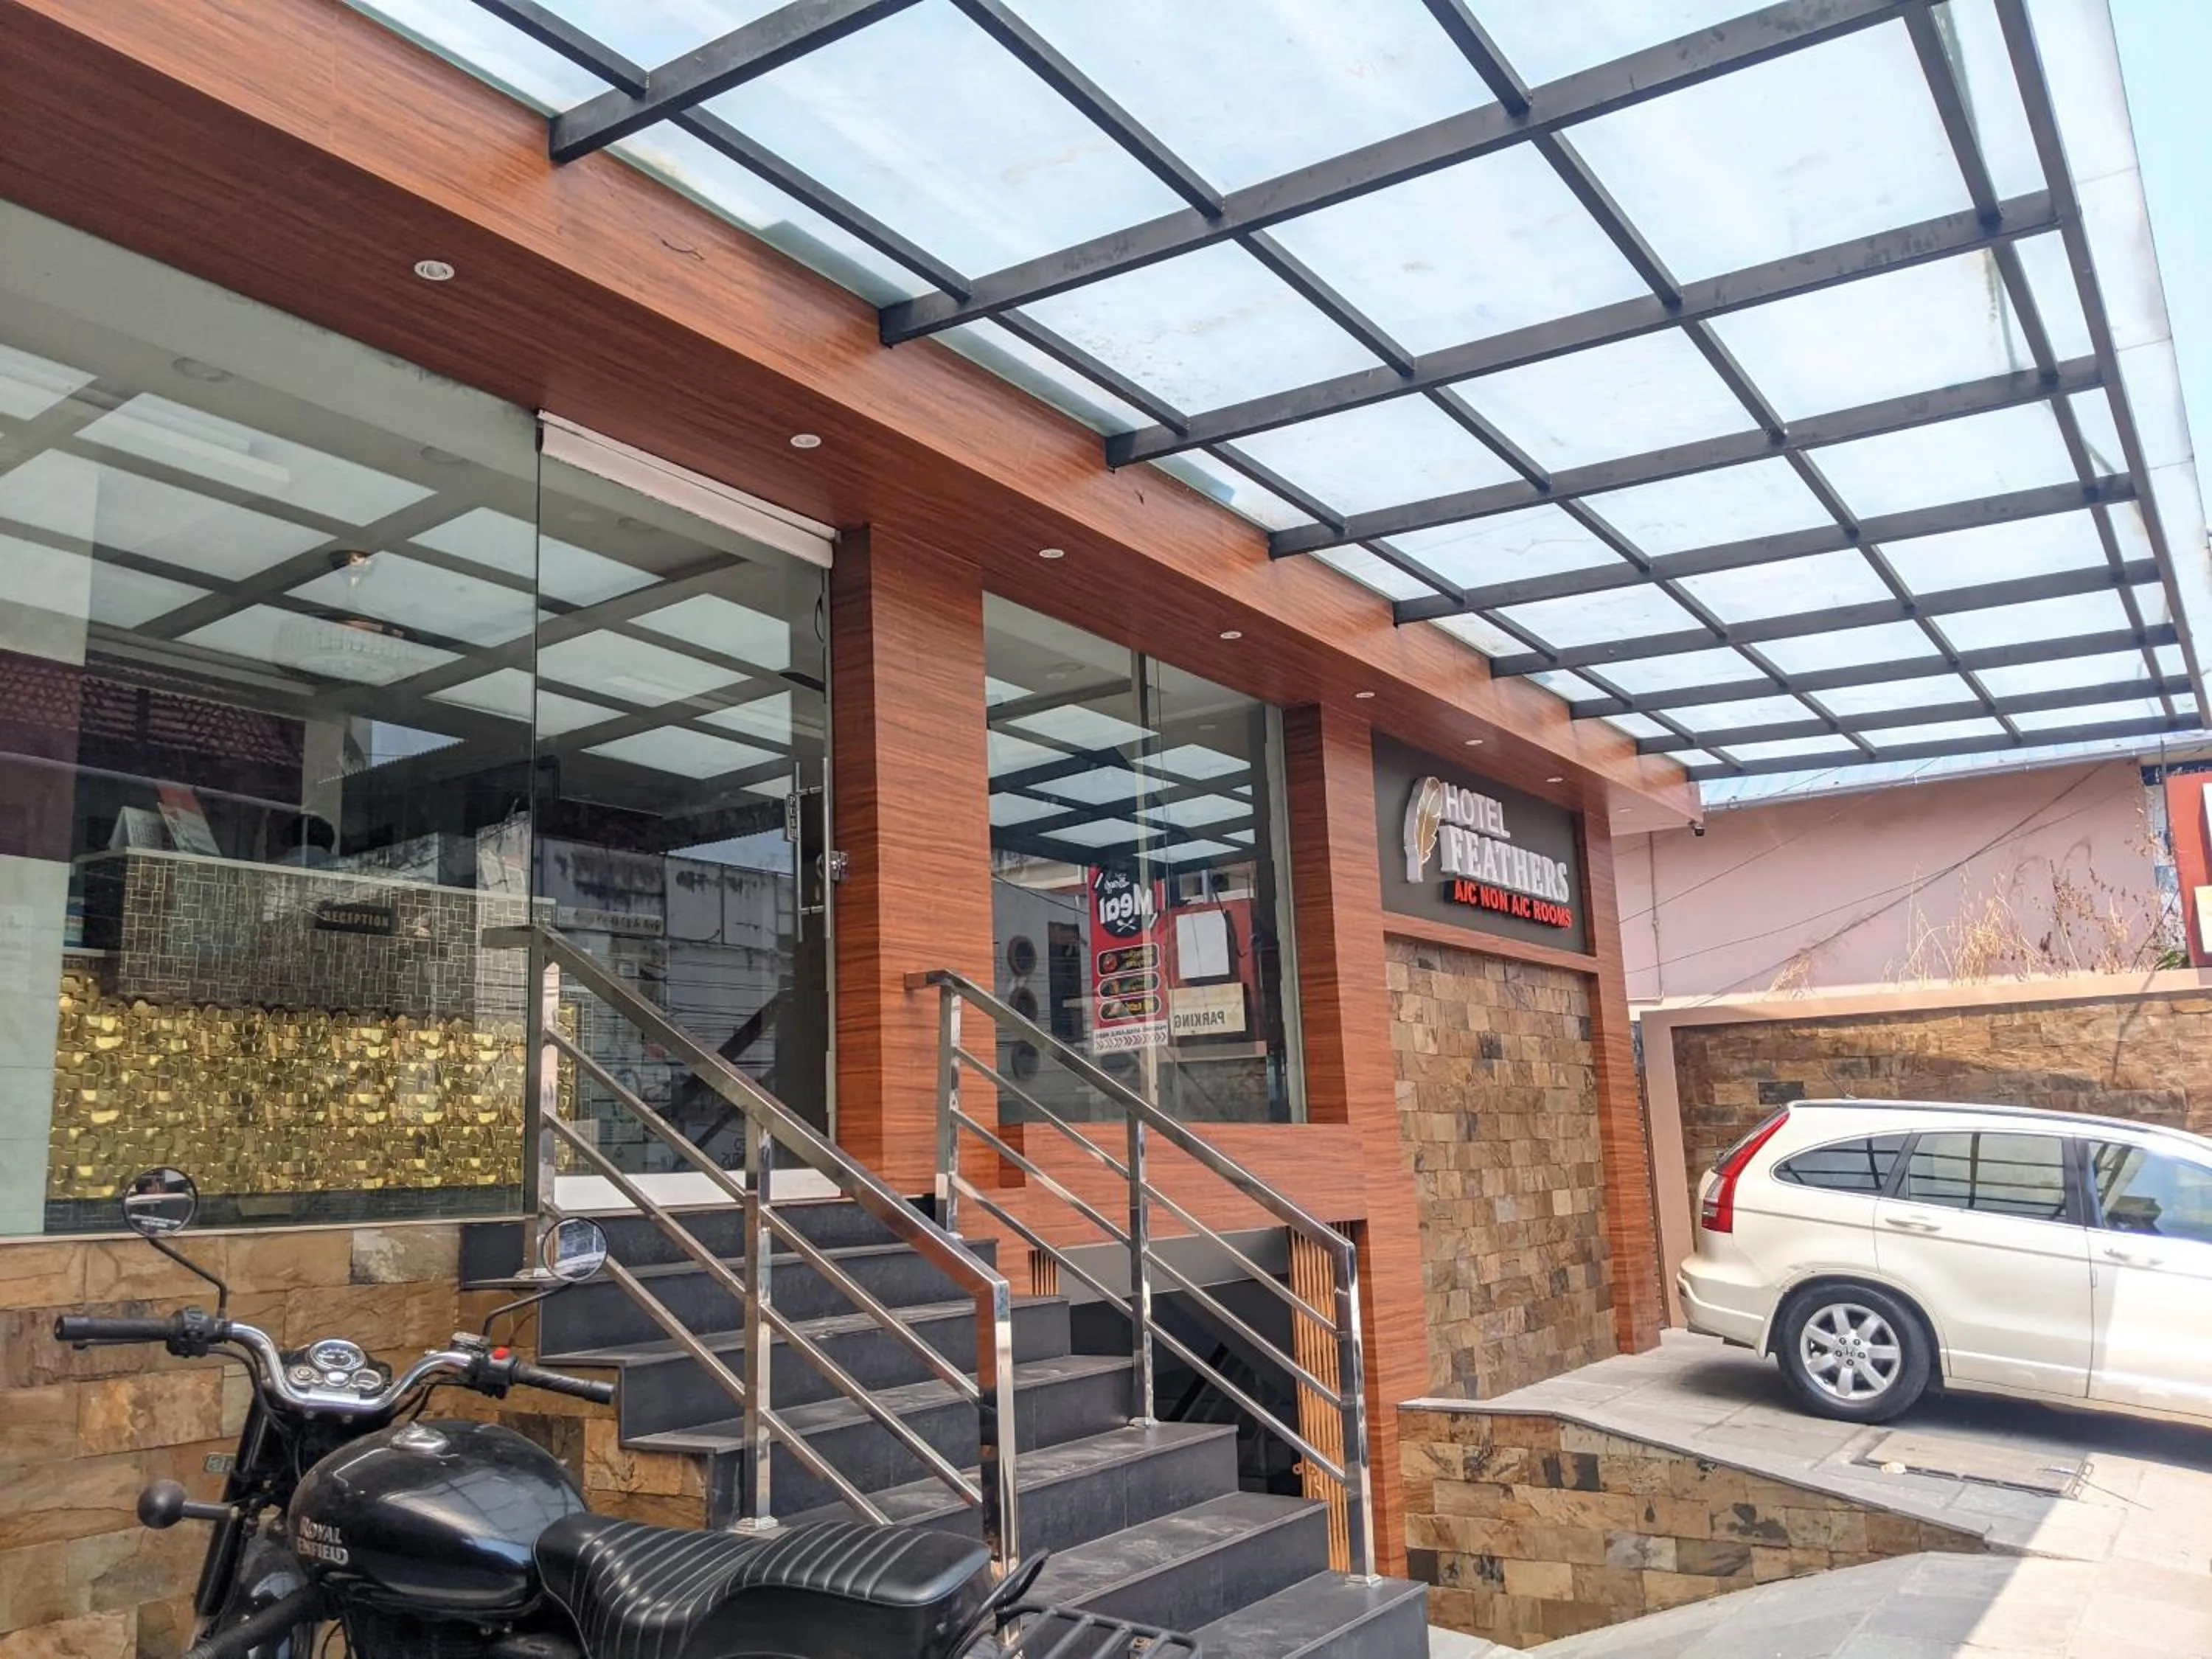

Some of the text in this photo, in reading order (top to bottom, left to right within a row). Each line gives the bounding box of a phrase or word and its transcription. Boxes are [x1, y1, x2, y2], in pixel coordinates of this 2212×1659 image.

[1440, 782, 1510, 838] HOTEL
[1439, 824, 1571, 903] FEATHERS
[324, 910, 389, 928] RECEPTION
[1455, 879, 1572, 929] A/C NON A/C ROOMS
[300, 1516, 342, 1544] ROYAL
[297, 1536, 349, 1565] ENFIELD
